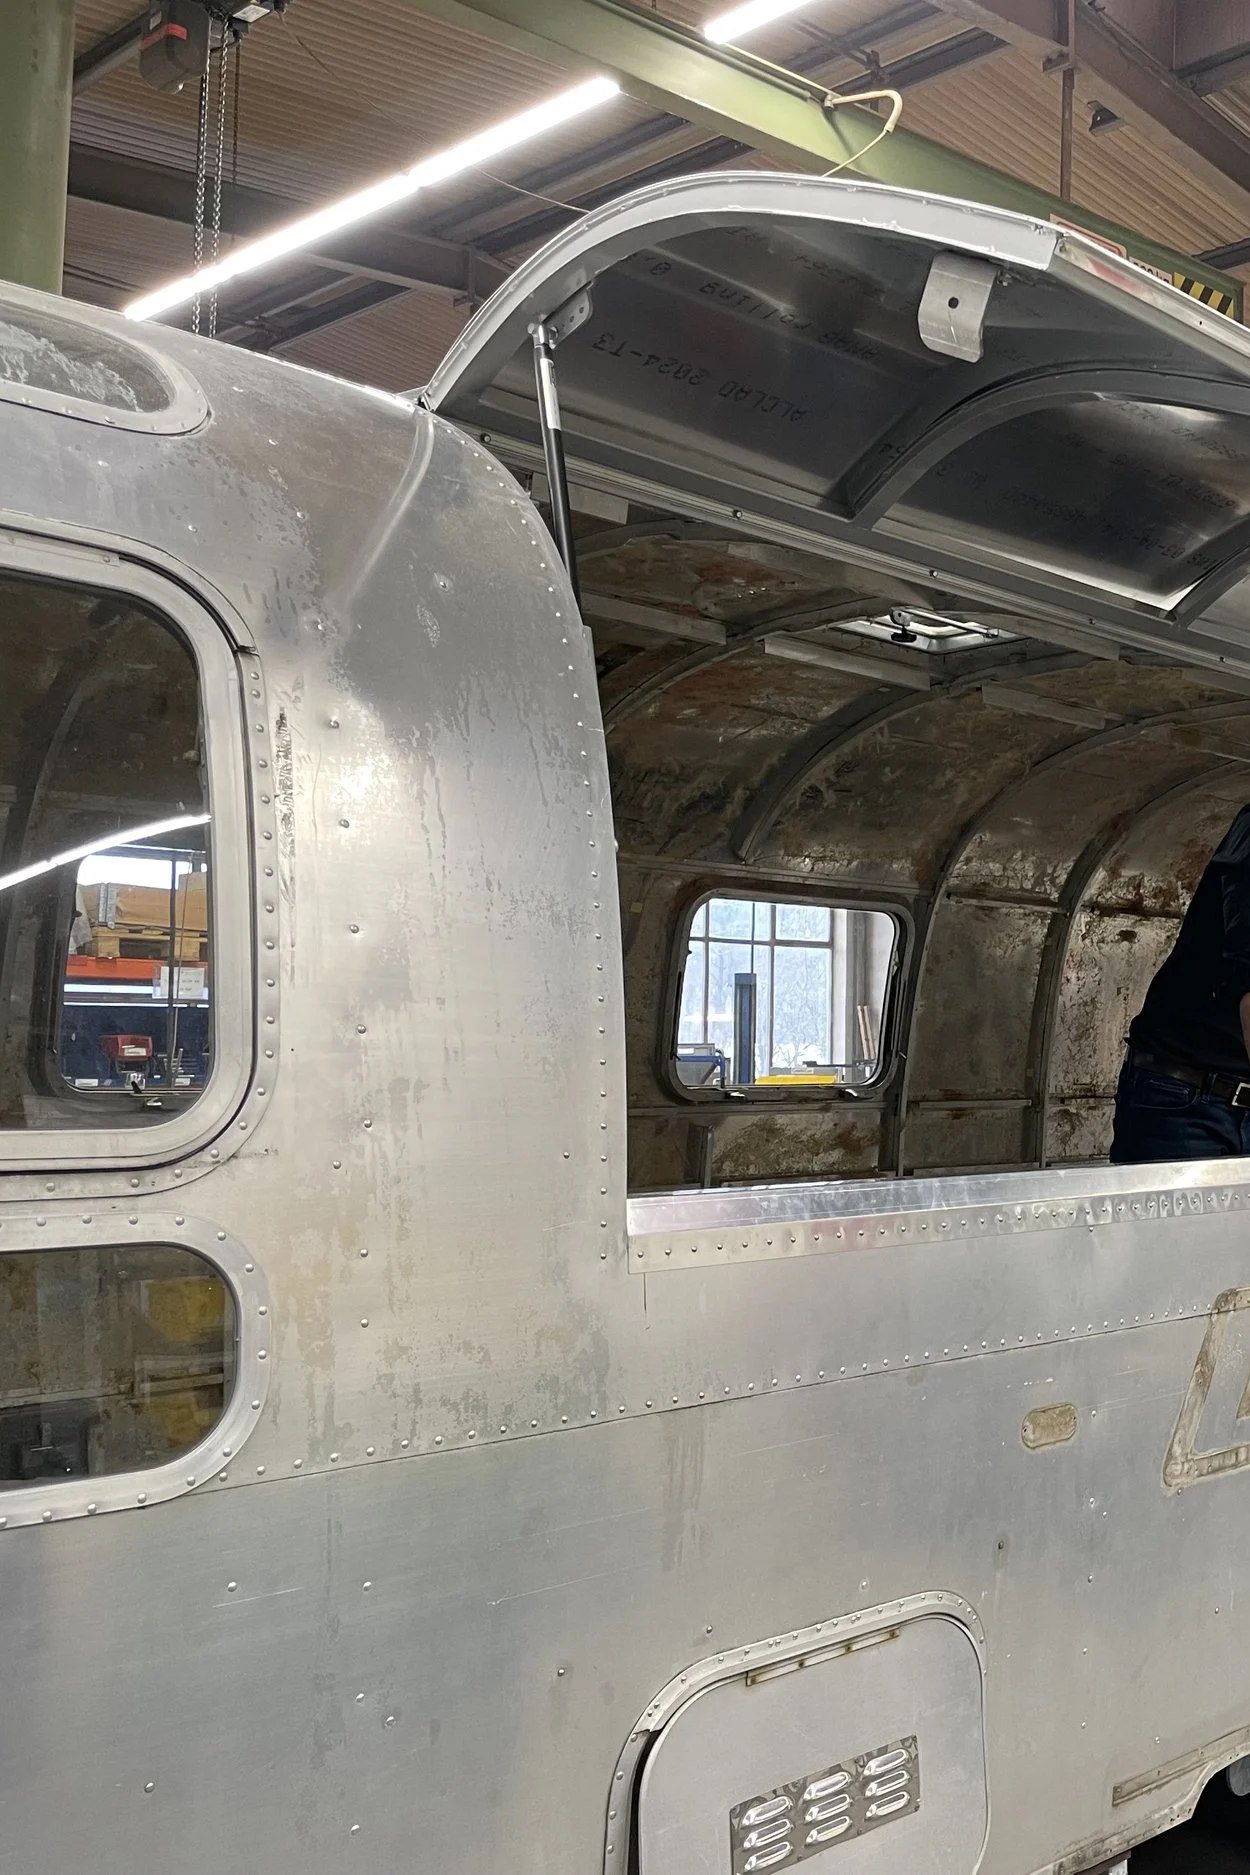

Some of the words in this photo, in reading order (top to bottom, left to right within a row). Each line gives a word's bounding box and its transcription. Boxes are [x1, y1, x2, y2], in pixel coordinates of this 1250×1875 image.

[700, 281, 812, 332] rolling
[591, 332, 711, 386] 2024-T3
[717, 380, 807, 423] ALCLAD
